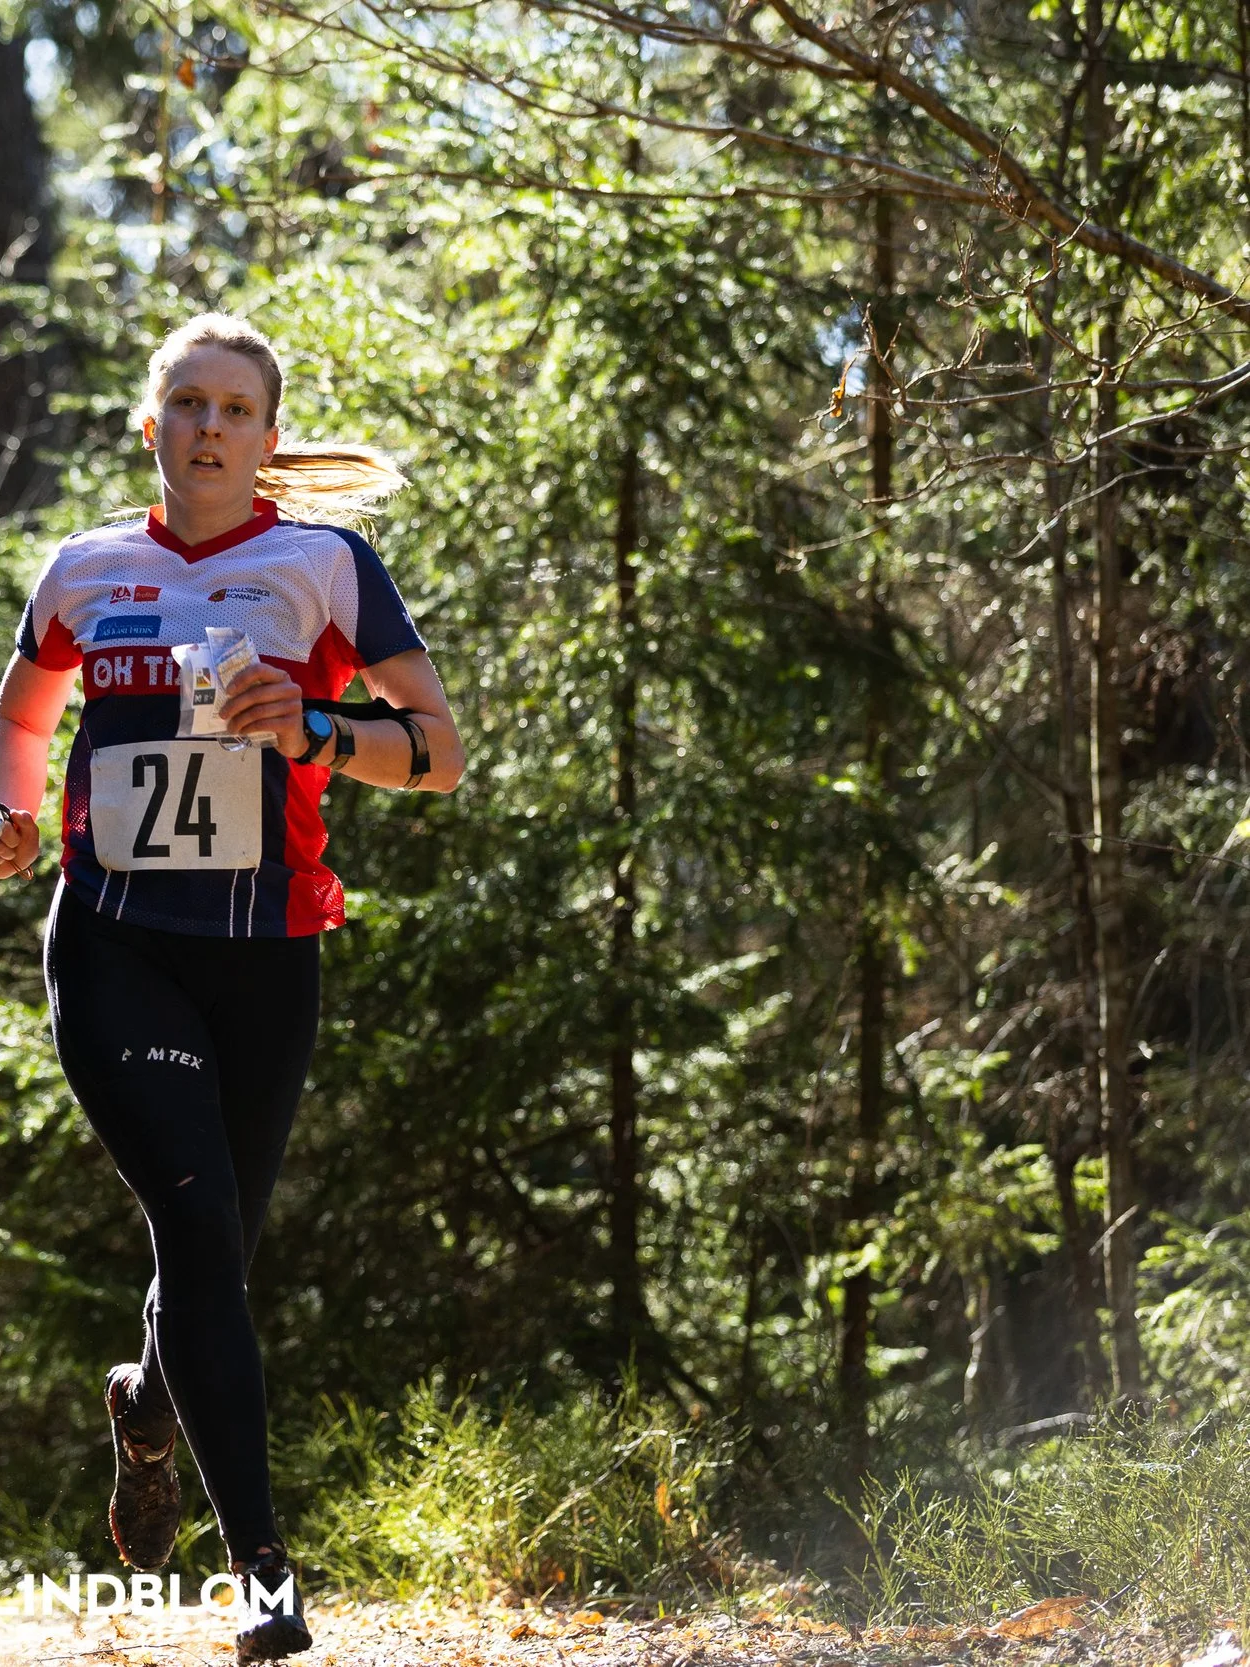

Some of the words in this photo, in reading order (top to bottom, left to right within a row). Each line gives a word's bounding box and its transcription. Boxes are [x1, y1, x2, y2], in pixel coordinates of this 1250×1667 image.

[225, 593, 261, 602] KOMMUN
[93, 655, 134, 688] OK
[132, 752, 217, 859] 24
[121, 1047, 204, 1070] MTEX
